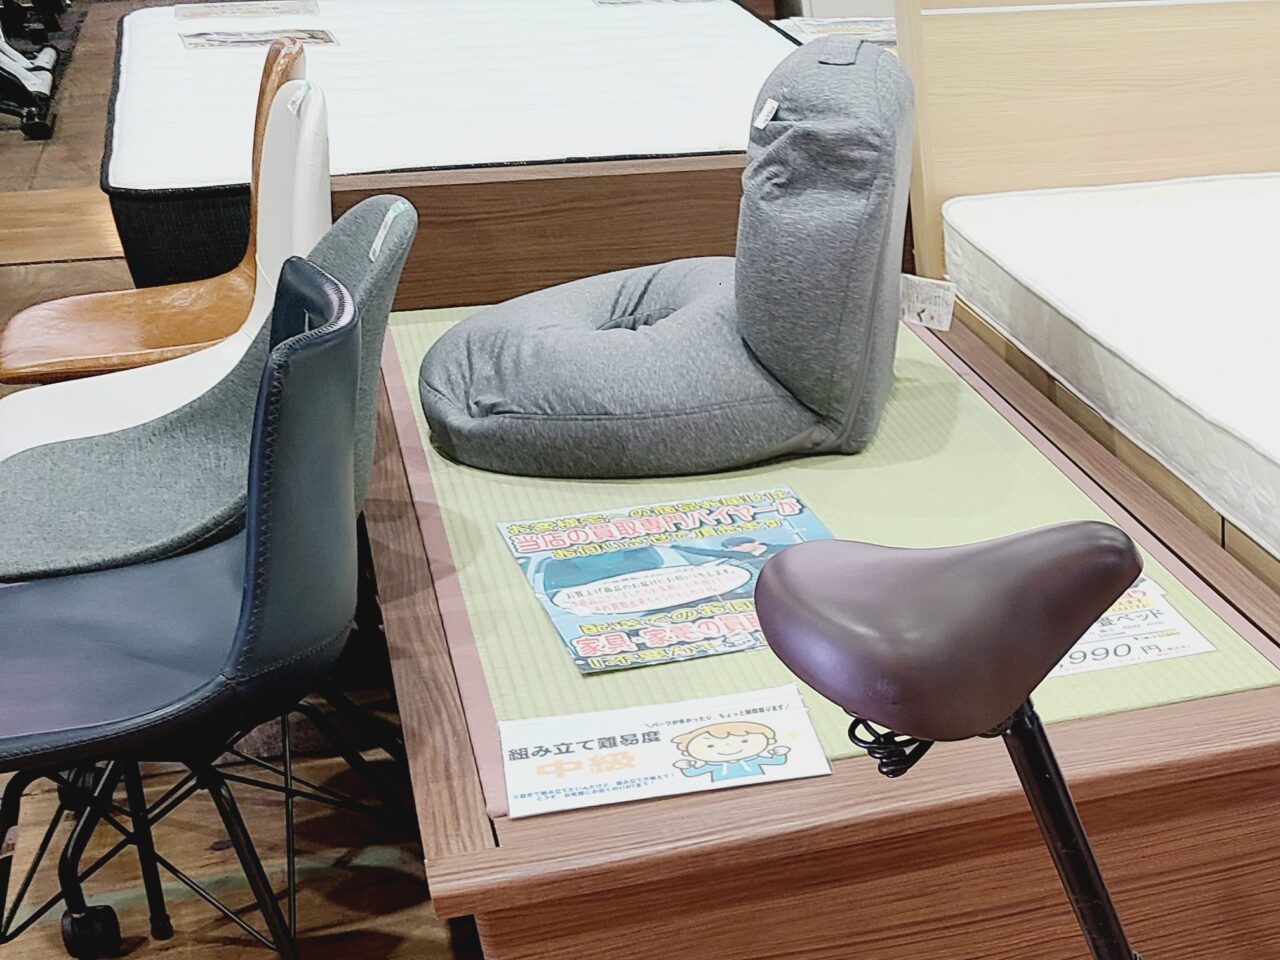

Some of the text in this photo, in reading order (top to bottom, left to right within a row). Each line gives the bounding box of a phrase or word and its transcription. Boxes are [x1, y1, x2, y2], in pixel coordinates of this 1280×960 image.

[507, 730, 663, 762] 組み立て難易度
[535, 749, 637, 780] 中級
